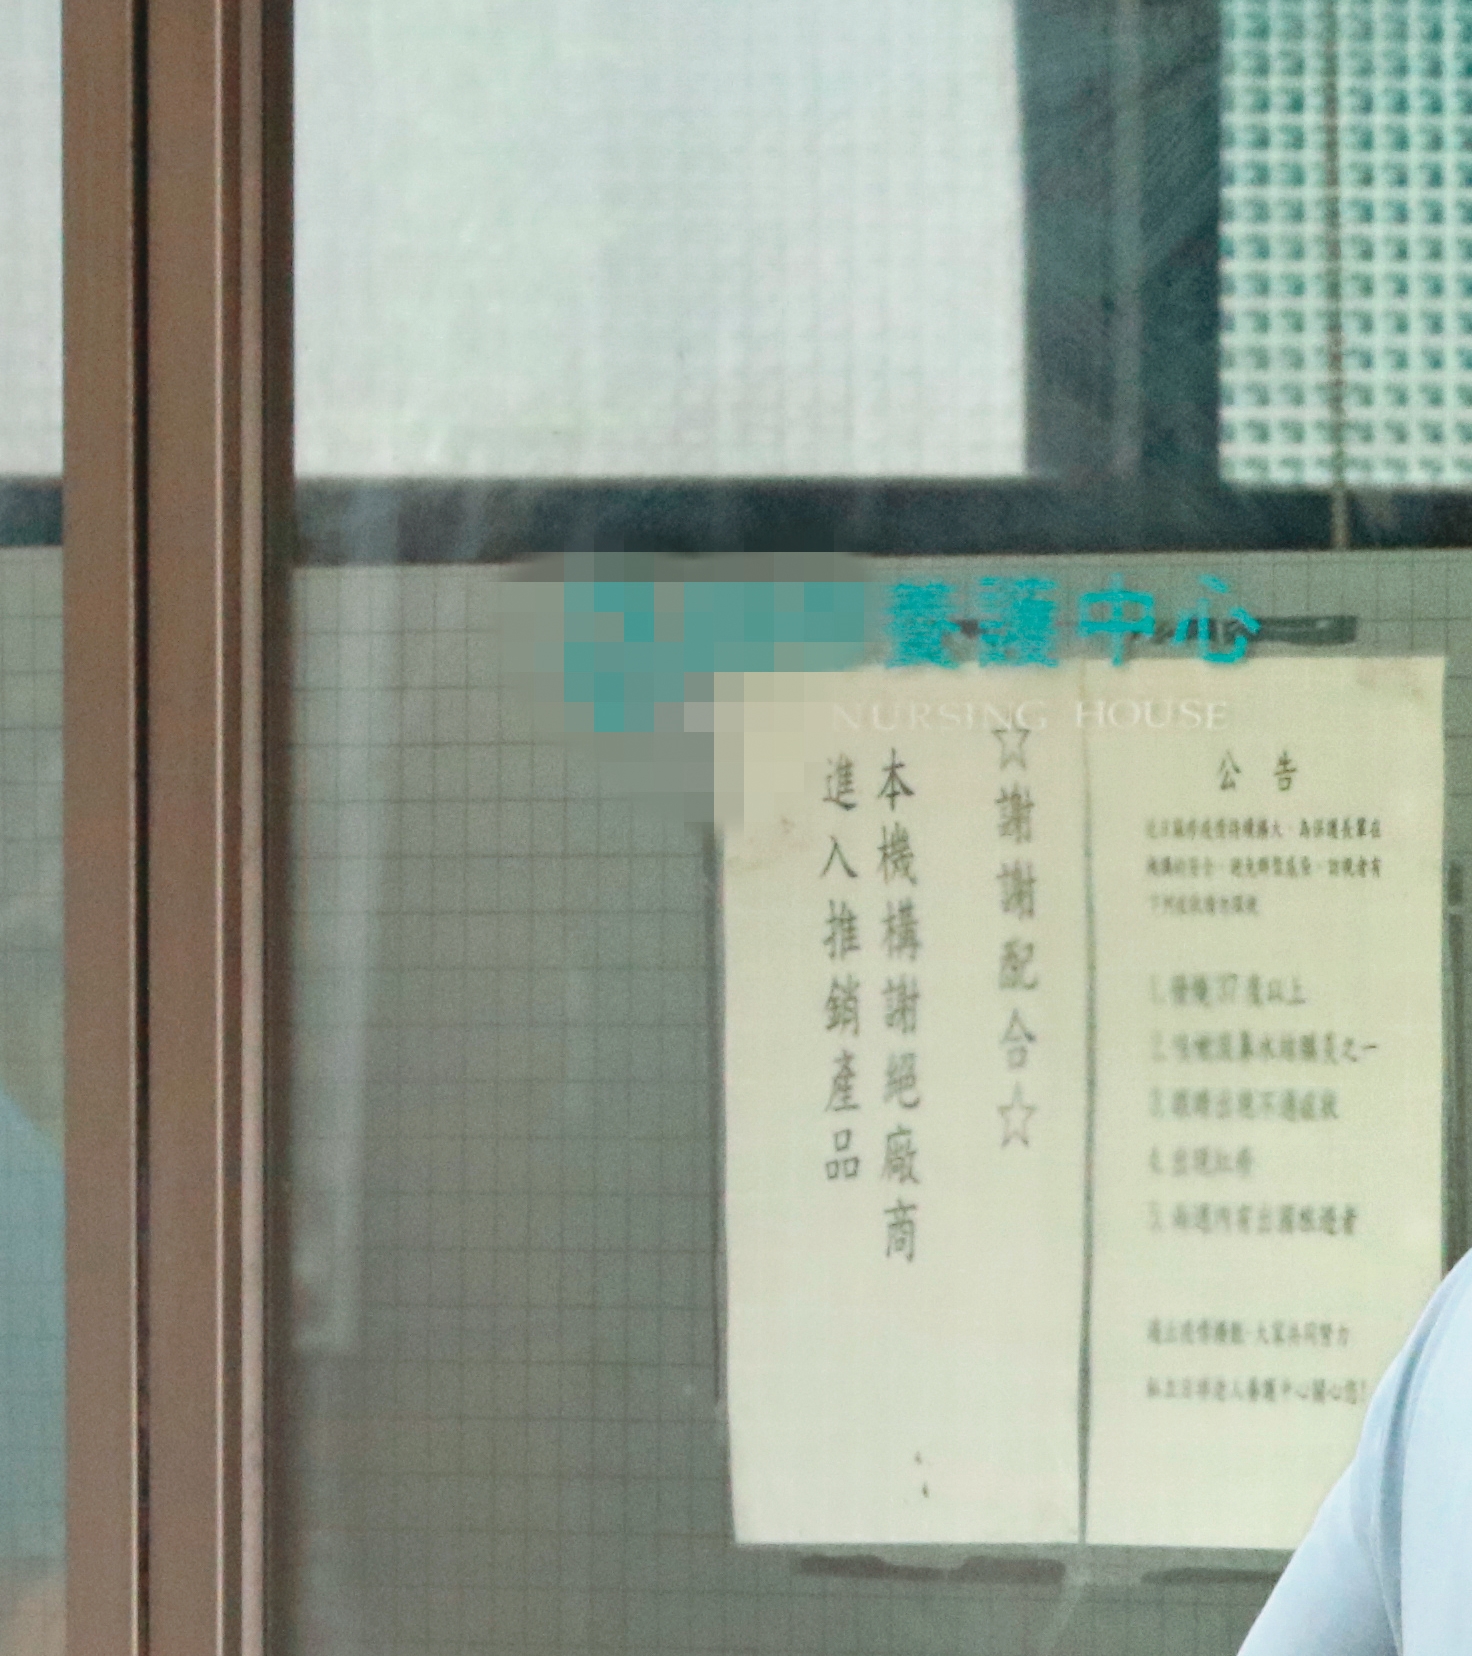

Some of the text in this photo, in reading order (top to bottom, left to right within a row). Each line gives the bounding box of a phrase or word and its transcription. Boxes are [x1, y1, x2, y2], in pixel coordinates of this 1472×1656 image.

[832, 697, 1229, 733] NURSING HOUSE
[819, 752, 862, 1184] 進入推銷產品
[876, 746, 921, 1265] 本機構謝絕廠商
